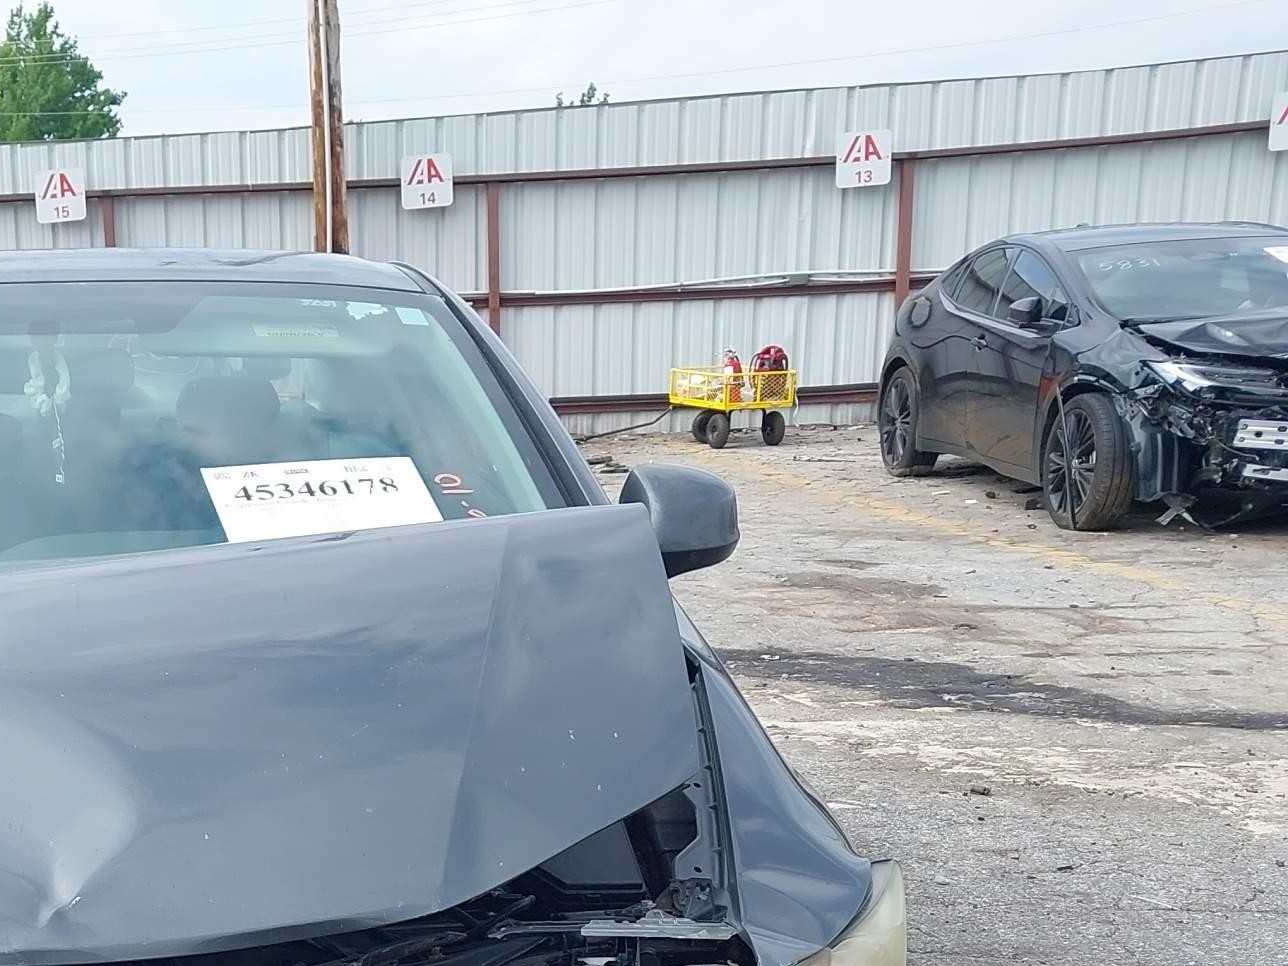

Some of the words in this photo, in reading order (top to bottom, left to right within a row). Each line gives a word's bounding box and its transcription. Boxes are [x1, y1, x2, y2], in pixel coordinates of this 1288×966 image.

[855, 169, 873, 184] 13
[419, 191, 436, 206] 14
[53, 205, 70, 219] 15
[1099, 255, 1161, 271] 5831
[234, 476, 400, 502] 45346178
